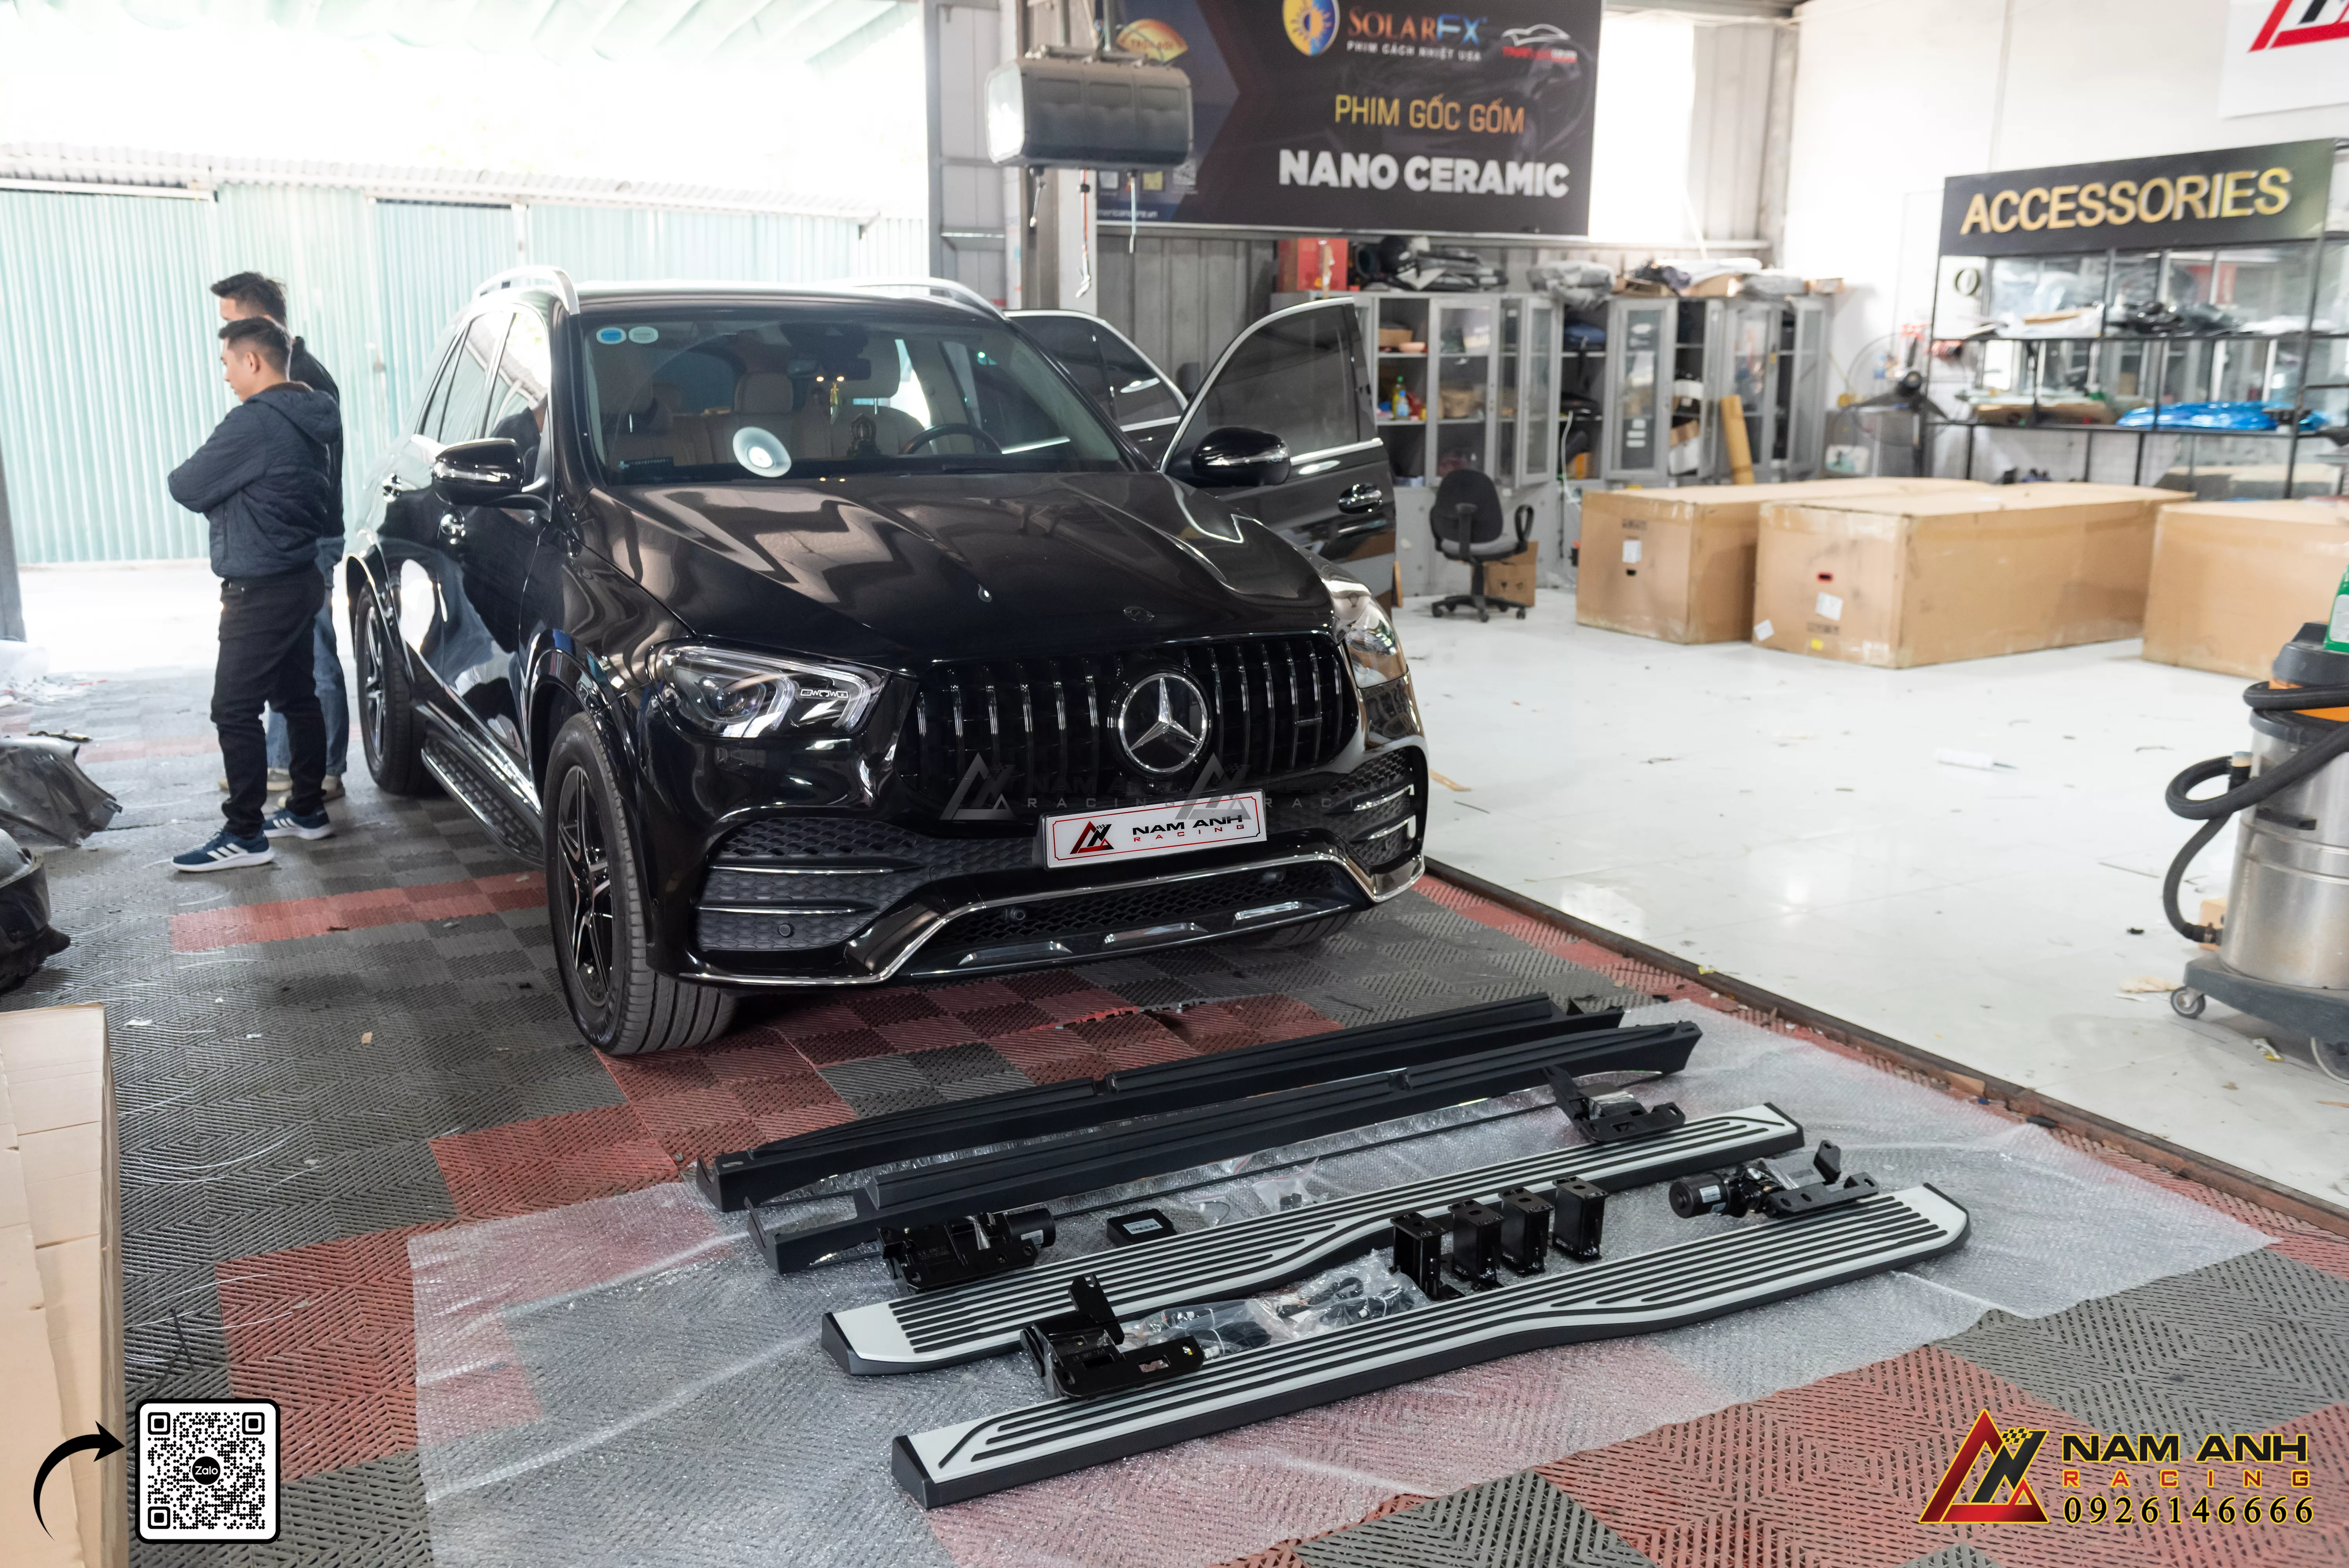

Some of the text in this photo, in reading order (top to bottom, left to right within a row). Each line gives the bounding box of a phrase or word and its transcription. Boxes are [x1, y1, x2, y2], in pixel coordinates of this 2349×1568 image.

[1347, 40, 1481, 62] PHIM CÁCH NHIỆT USA
[1335, 93, 1525, 134] PHIM GỐC GỐM
[1279, 149, 1570, 198] NANO CERAMIC
[1960, 167, 2293, 235] ACCESSORIES
[1132, 814, 1243, 835] NAM ANH
[1134, 824, 1244, 842] RACING
